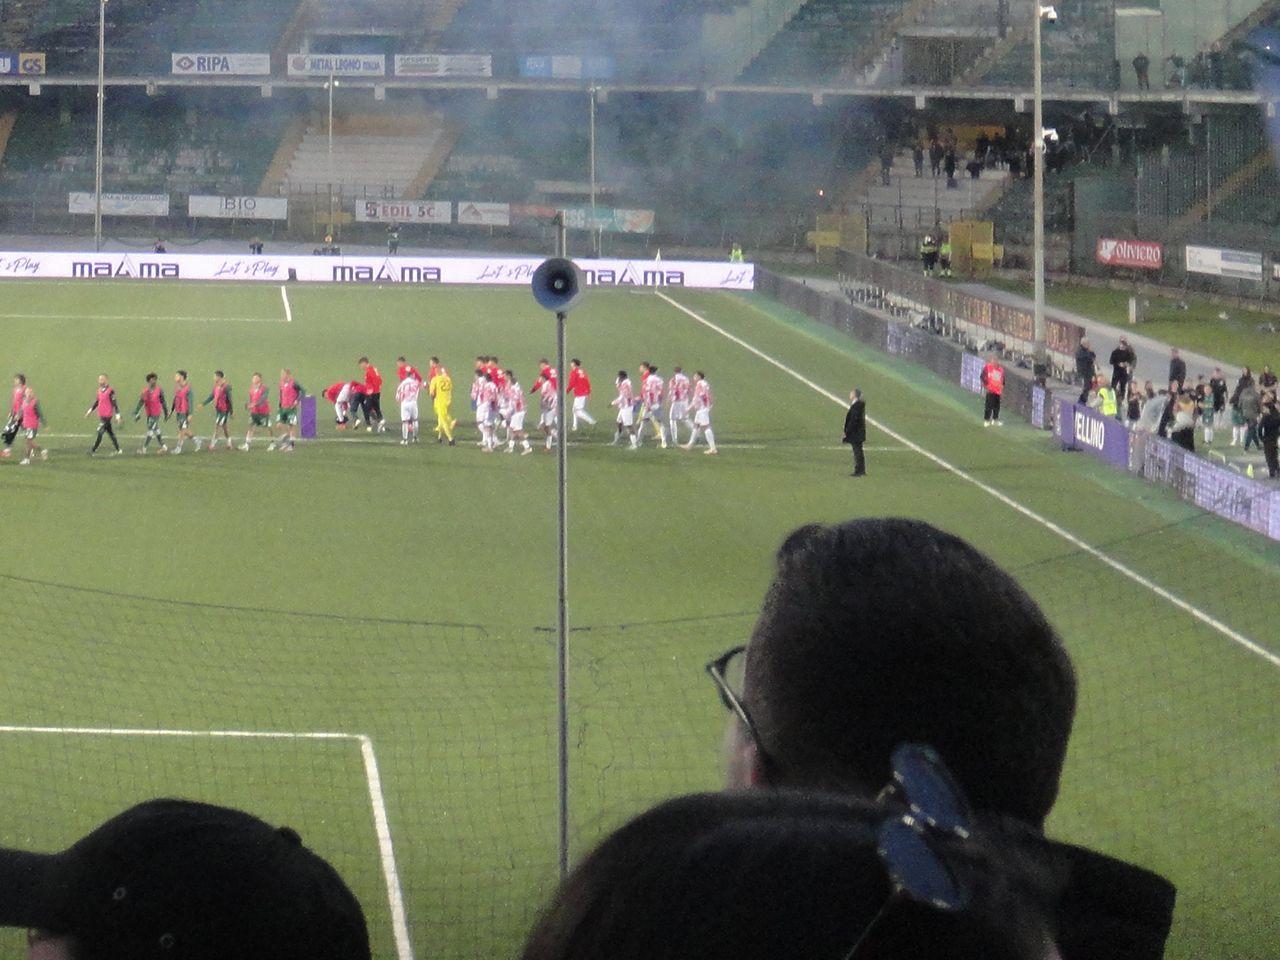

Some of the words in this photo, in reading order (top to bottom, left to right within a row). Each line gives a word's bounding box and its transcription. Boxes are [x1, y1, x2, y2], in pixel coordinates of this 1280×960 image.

[196, 55, 231, 72] RIPA
[381, 205, 412, 217] EDIL
[13, 256, 42, 274] Play
[252, 259, 280, 277] Play
